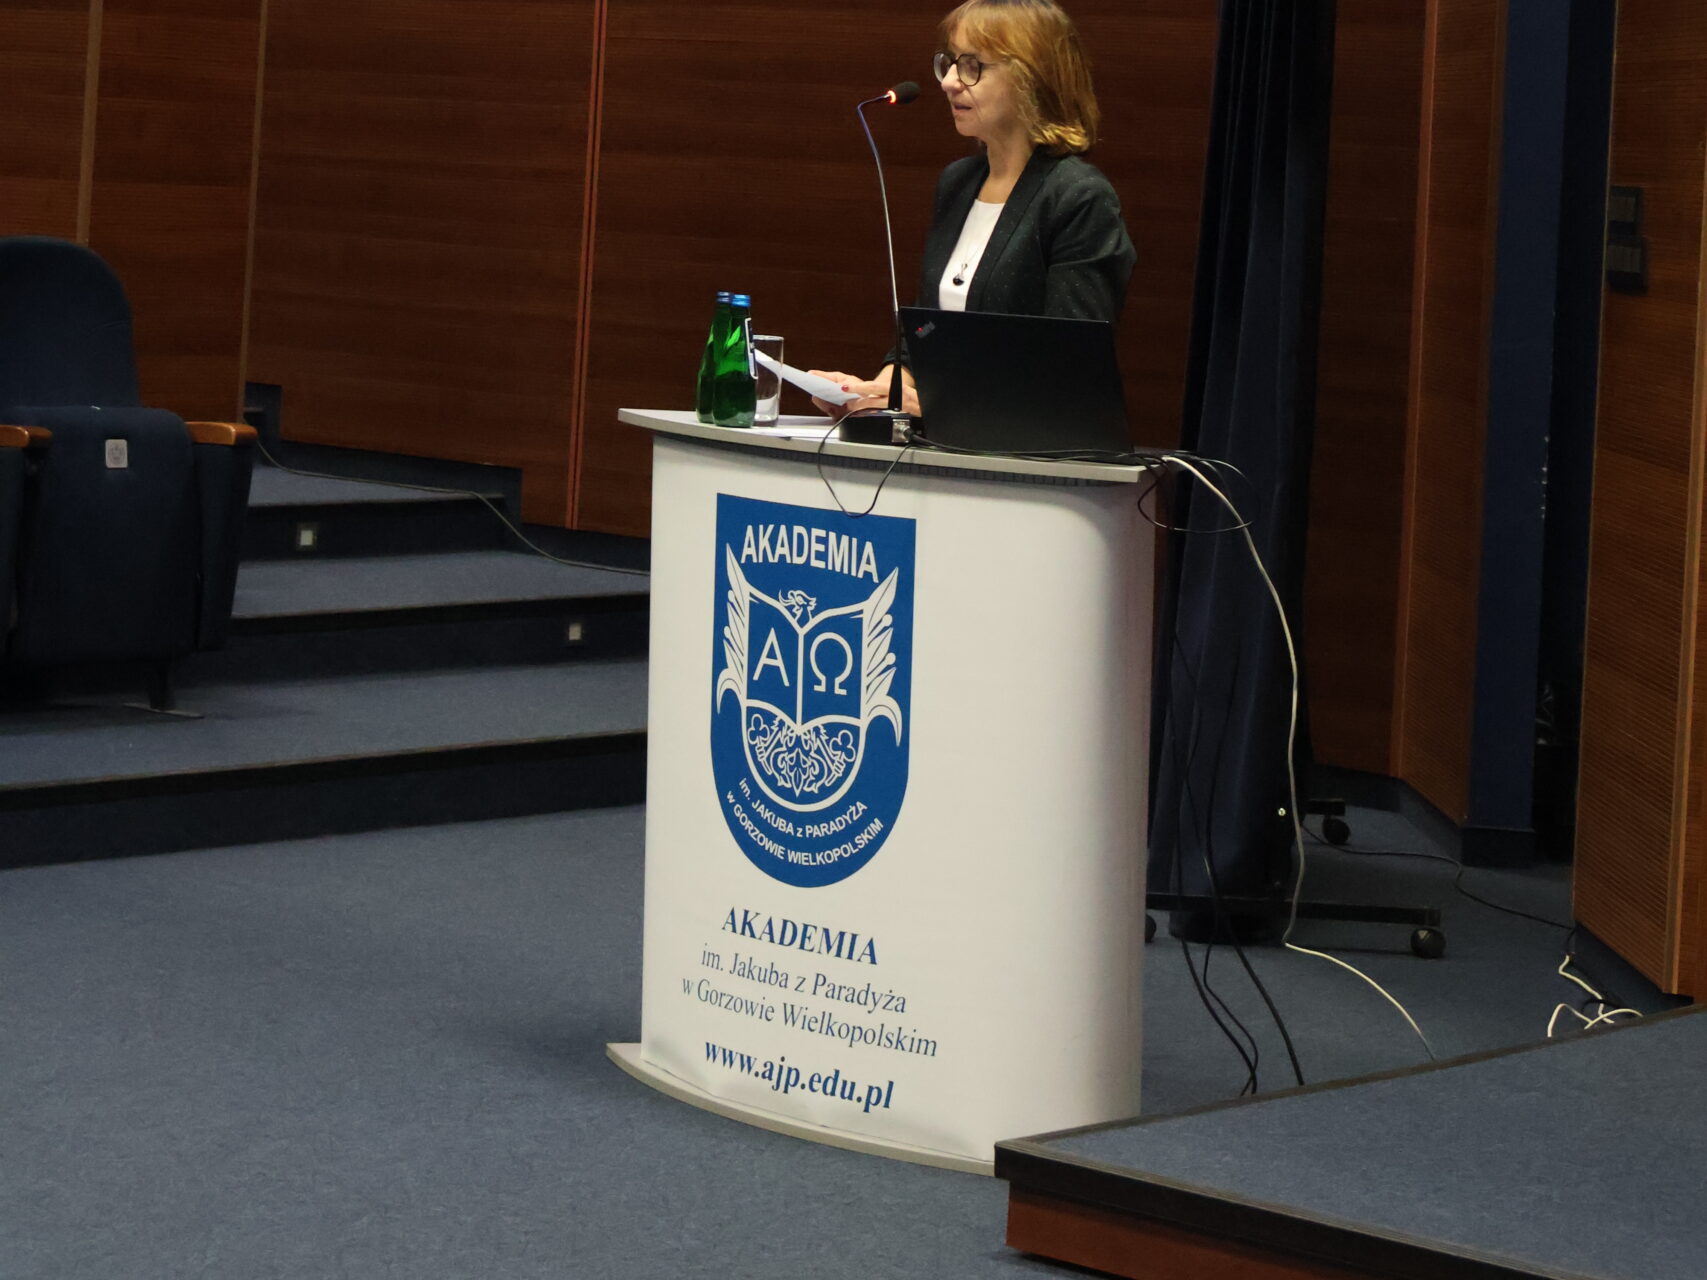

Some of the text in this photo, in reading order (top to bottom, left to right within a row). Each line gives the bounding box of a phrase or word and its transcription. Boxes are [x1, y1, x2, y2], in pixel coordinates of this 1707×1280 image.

[741, 524, 880, 583] AKADEMIA
[752, 627, 789, 687] A
[733, 803, 786, 860] GORZOWIE
[787, 817, 884, 866] WIELKOPOLSKIM
[739, 777, 751, 801] im.
[752, 799, 795, 836] JAKUBA
[805, 800, 868, 838] PARADYŻA
[721, 906, 878, 966] AKADEMIA
[701, 942, 907, 1015] im. Jakuba z Paradyża
[682, 976, 938, 1057] w Gorzowie Wielkopolskim
[705, 1041, 895, 1114] www.ajp.edu.pl
